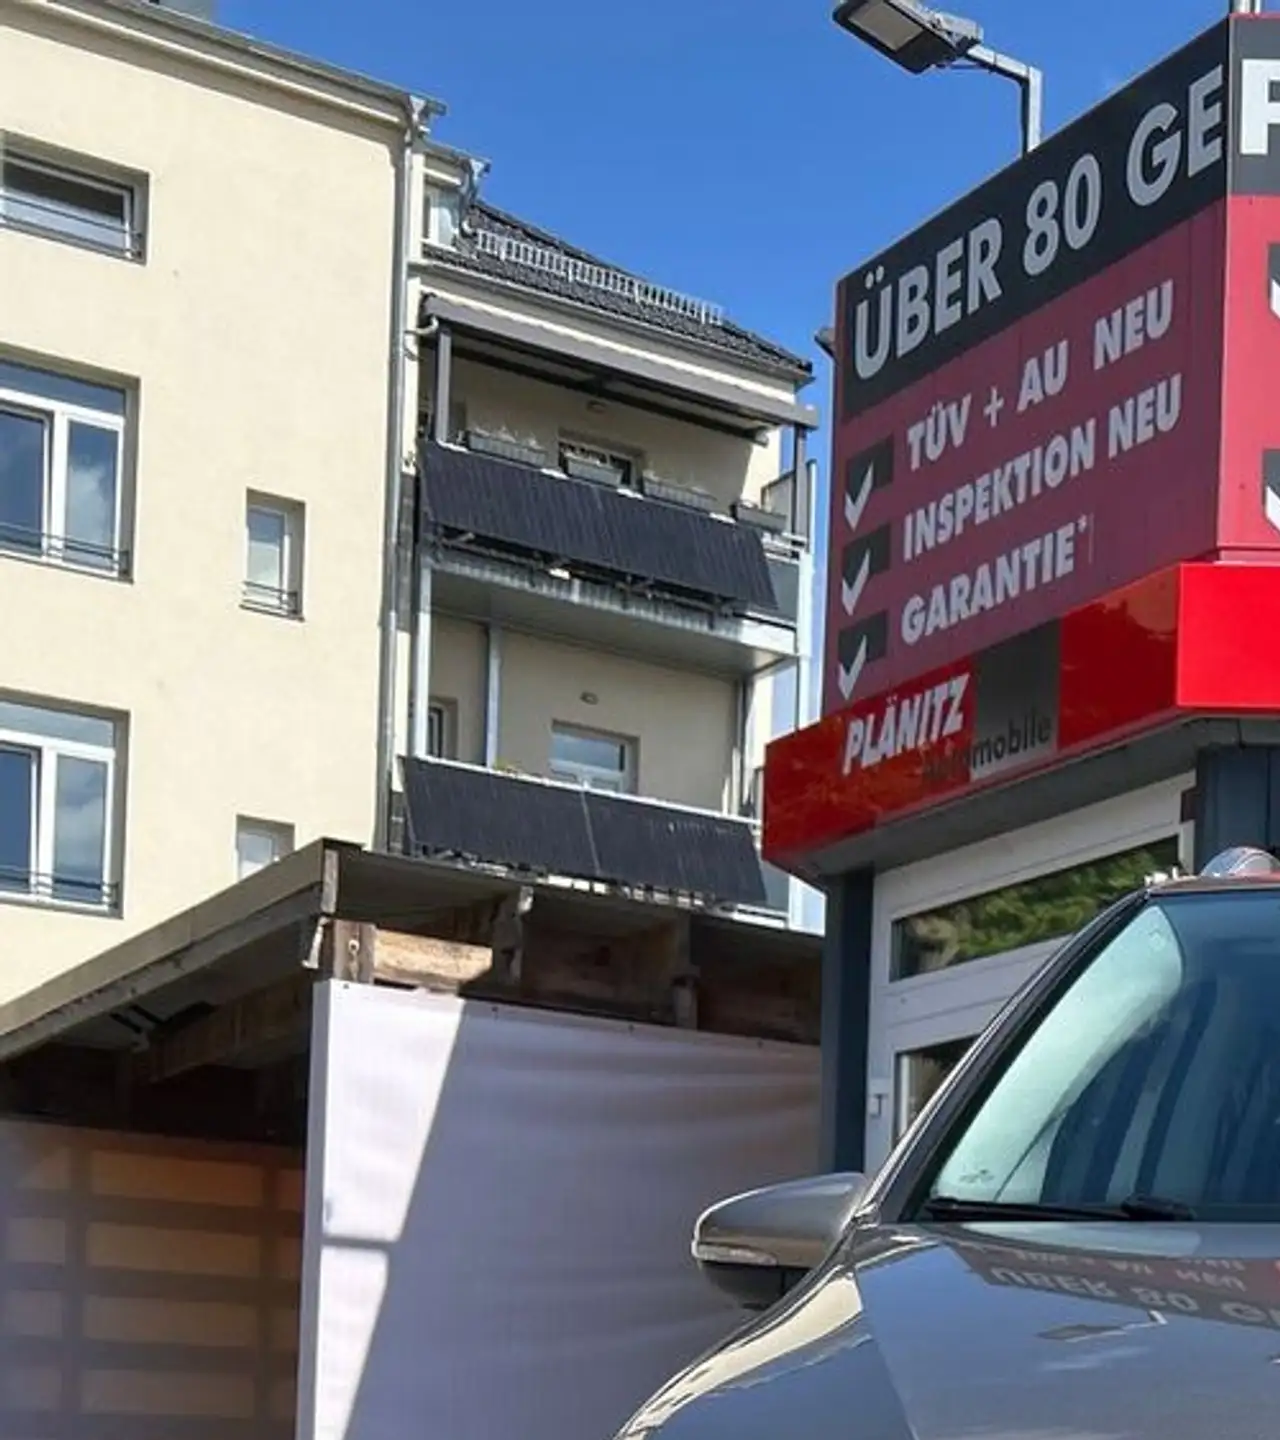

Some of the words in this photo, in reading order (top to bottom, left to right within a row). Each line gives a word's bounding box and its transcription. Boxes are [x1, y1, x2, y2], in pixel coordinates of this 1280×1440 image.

[853, 265, 1002, 380] ÜBER
[1023, 154, 1102, 276] 80
[903, 417, 1095, 561] INSPEKTION
[1107, 373, 1182, 460] NEU
[906, 401, 973, 473] TÜV
[1017, 339, 1069, 415] AU
[1093, 279, 1174, 371] NEU
[843, 673, 970, 775] PLÄNITZ
